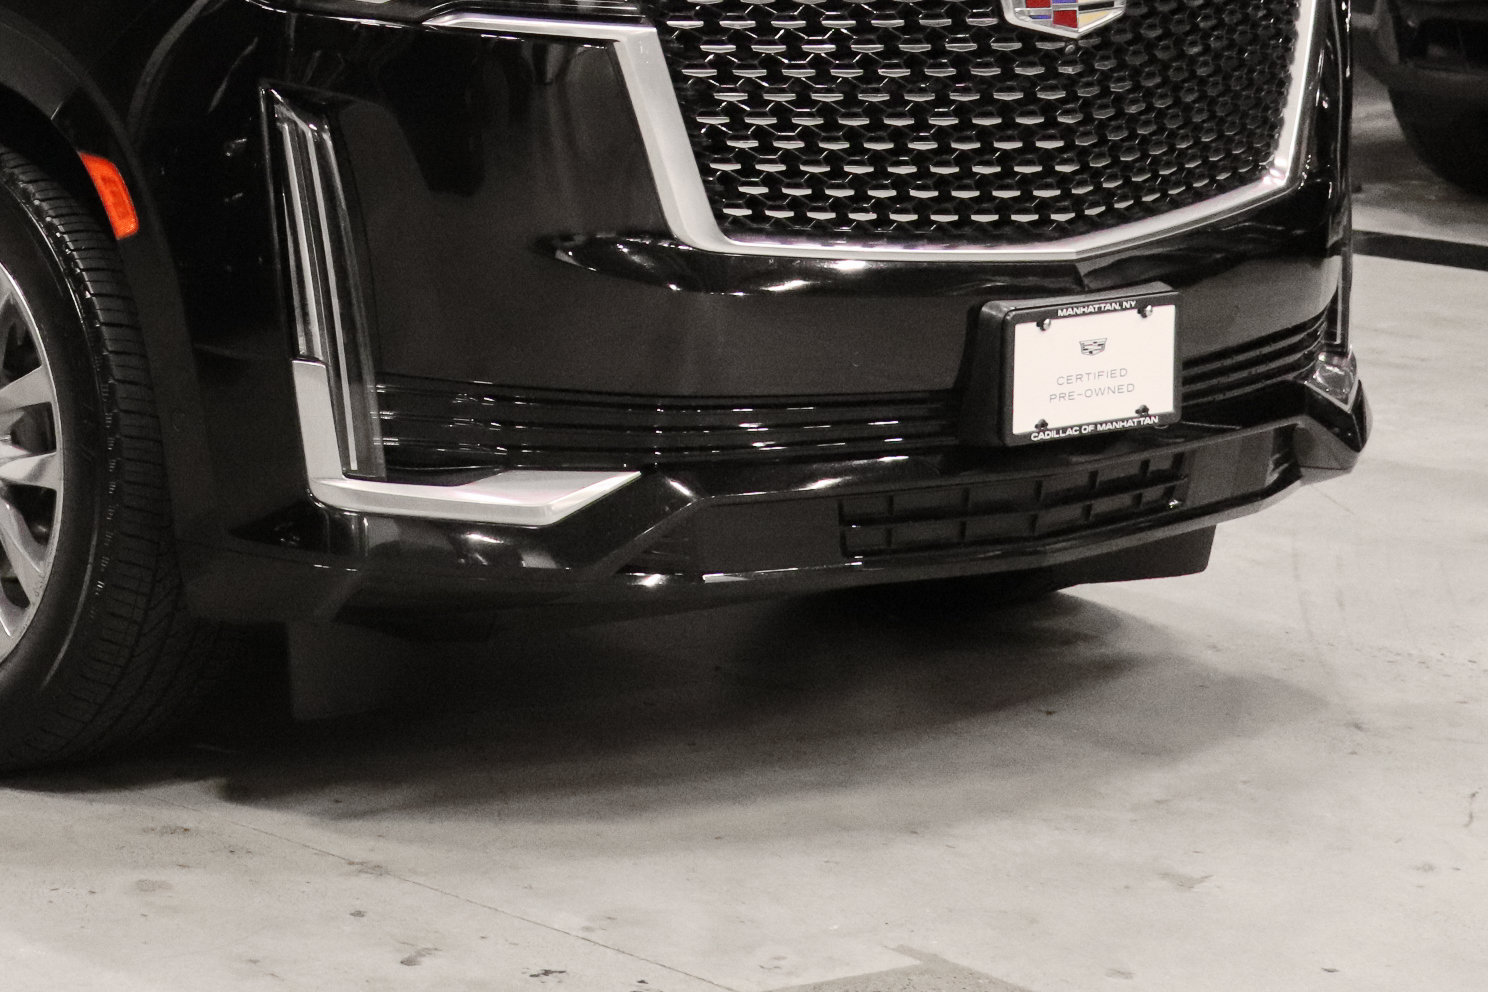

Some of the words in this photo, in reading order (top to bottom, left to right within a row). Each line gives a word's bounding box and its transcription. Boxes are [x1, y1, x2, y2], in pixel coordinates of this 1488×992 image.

[1122, 300, 1137, 310] NY
[1056, 367, 1128, 386] CERTIFIED
[1049, 383, 1135, 403] PRE-OWNED
[1030, 426, 1080, 441] CADILLAC
[1081, 424, 1096, 434] OF
[1096, 415, 1159, 432] MANHATTAN
